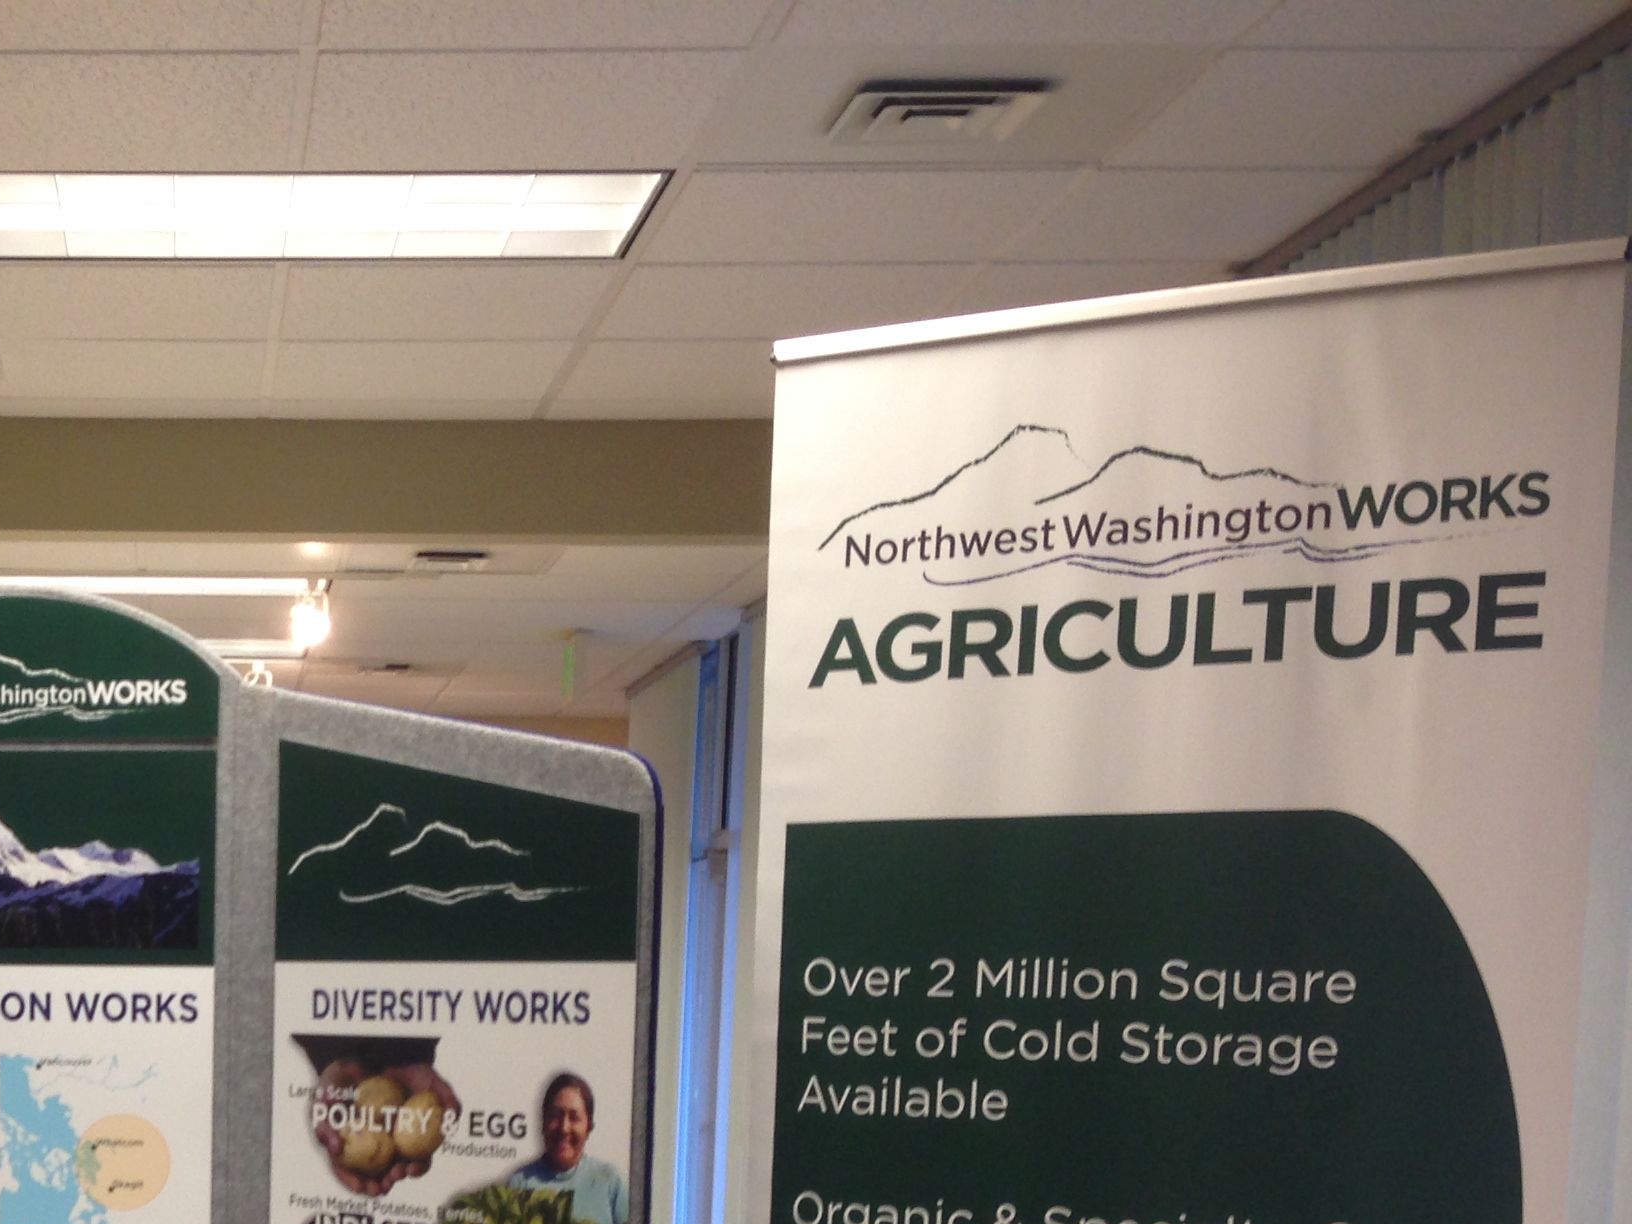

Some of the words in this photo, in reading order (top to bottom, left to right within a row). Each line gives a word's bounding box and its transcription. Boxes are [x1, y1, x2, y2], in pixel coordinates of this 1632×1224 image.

[845, 517, 1056, 568] Northwest
[1063, 500, 1333, 548] Washington
[1337, 471, 1551, 531] WORKS
[807, 571, 1547, 689] AGRICULTURE
[87, 679, 187, 705] WORKS
[804, 957, 911, 999] Over
[927, 959, 956, 998] 2
[975, 958, 1138, 1000] Million
[1159, 959, 1357, 1009] Square
[66, 992, 199, 1023] WORKS
[312, 989, 463, 1023] DIVERSITY
[474, 990, 591, 1025] WORKS
[801, 1016, 897, 1057] Feet
[915, 1017, 967, 1058] of
[983, 1019, 1099, 1063] Cold
[1121, 1022, 1338, 1076] Storage
[312, 1102, 433, 1134] POULTRY
[469, 1111, 528, 1140] EGG
[798, 1075, 1008, 1122] Available
